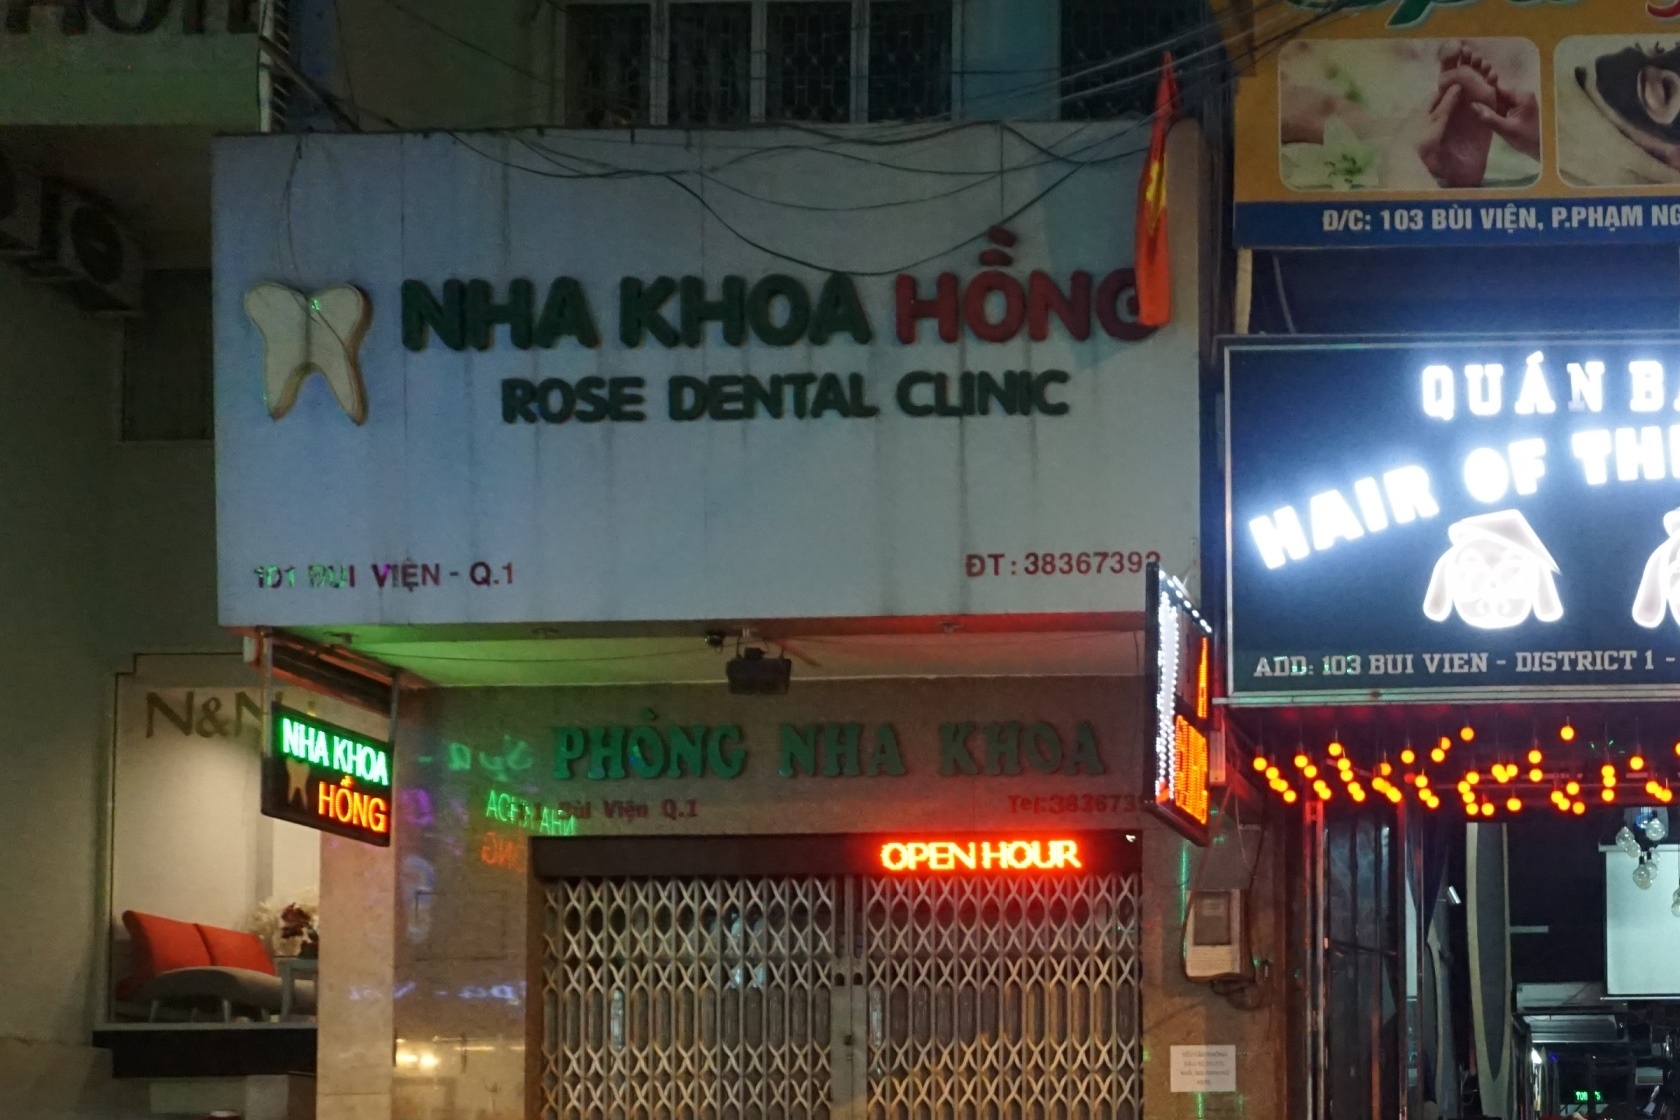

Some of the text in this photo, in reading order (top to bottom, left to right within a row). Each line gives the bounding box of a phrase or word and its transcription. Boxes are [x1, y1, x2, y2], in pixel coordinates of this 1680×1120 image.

[1322, 208, 1371, 231] Đ/C:
[1381, 208, 1423, 231] 103
[1431, 203, 1472, 231] BÙI
[1480, 203, 1544, 234] VIỆN,
[1552, 203, 1643, 232] P.PHẠM
[401, 226, 1157, 352] NHA KHOA HỒNG
[501, 368, 1070, 425] ROSE DENTAL CLINIC
[1421, 350, 1605, 421] QUÁN
[1249, 464, 1440, 570] HAIR
[1462, 438, 1547, 504] OF
[469, 561, 515, 588] Q.1
[1321, 655, 1361, 677] 103
[1369, 654, 1414, 676] BUI
[1424, 652, 1489, 675] VIEN
[1515, 650, 1638, 672] DISTRICT
[1644, 650, 1655, 670] 1
[281, 716, 330, 768] NHA
[333, 734, 390, 787] KHOA
[553, 707, 749, 780] PHÒNG
[779, 723, 908, 779] NHA
[939, 718, 1108, 778] KHOA
[880, 838, 1082, 871] OPEN HOUR
